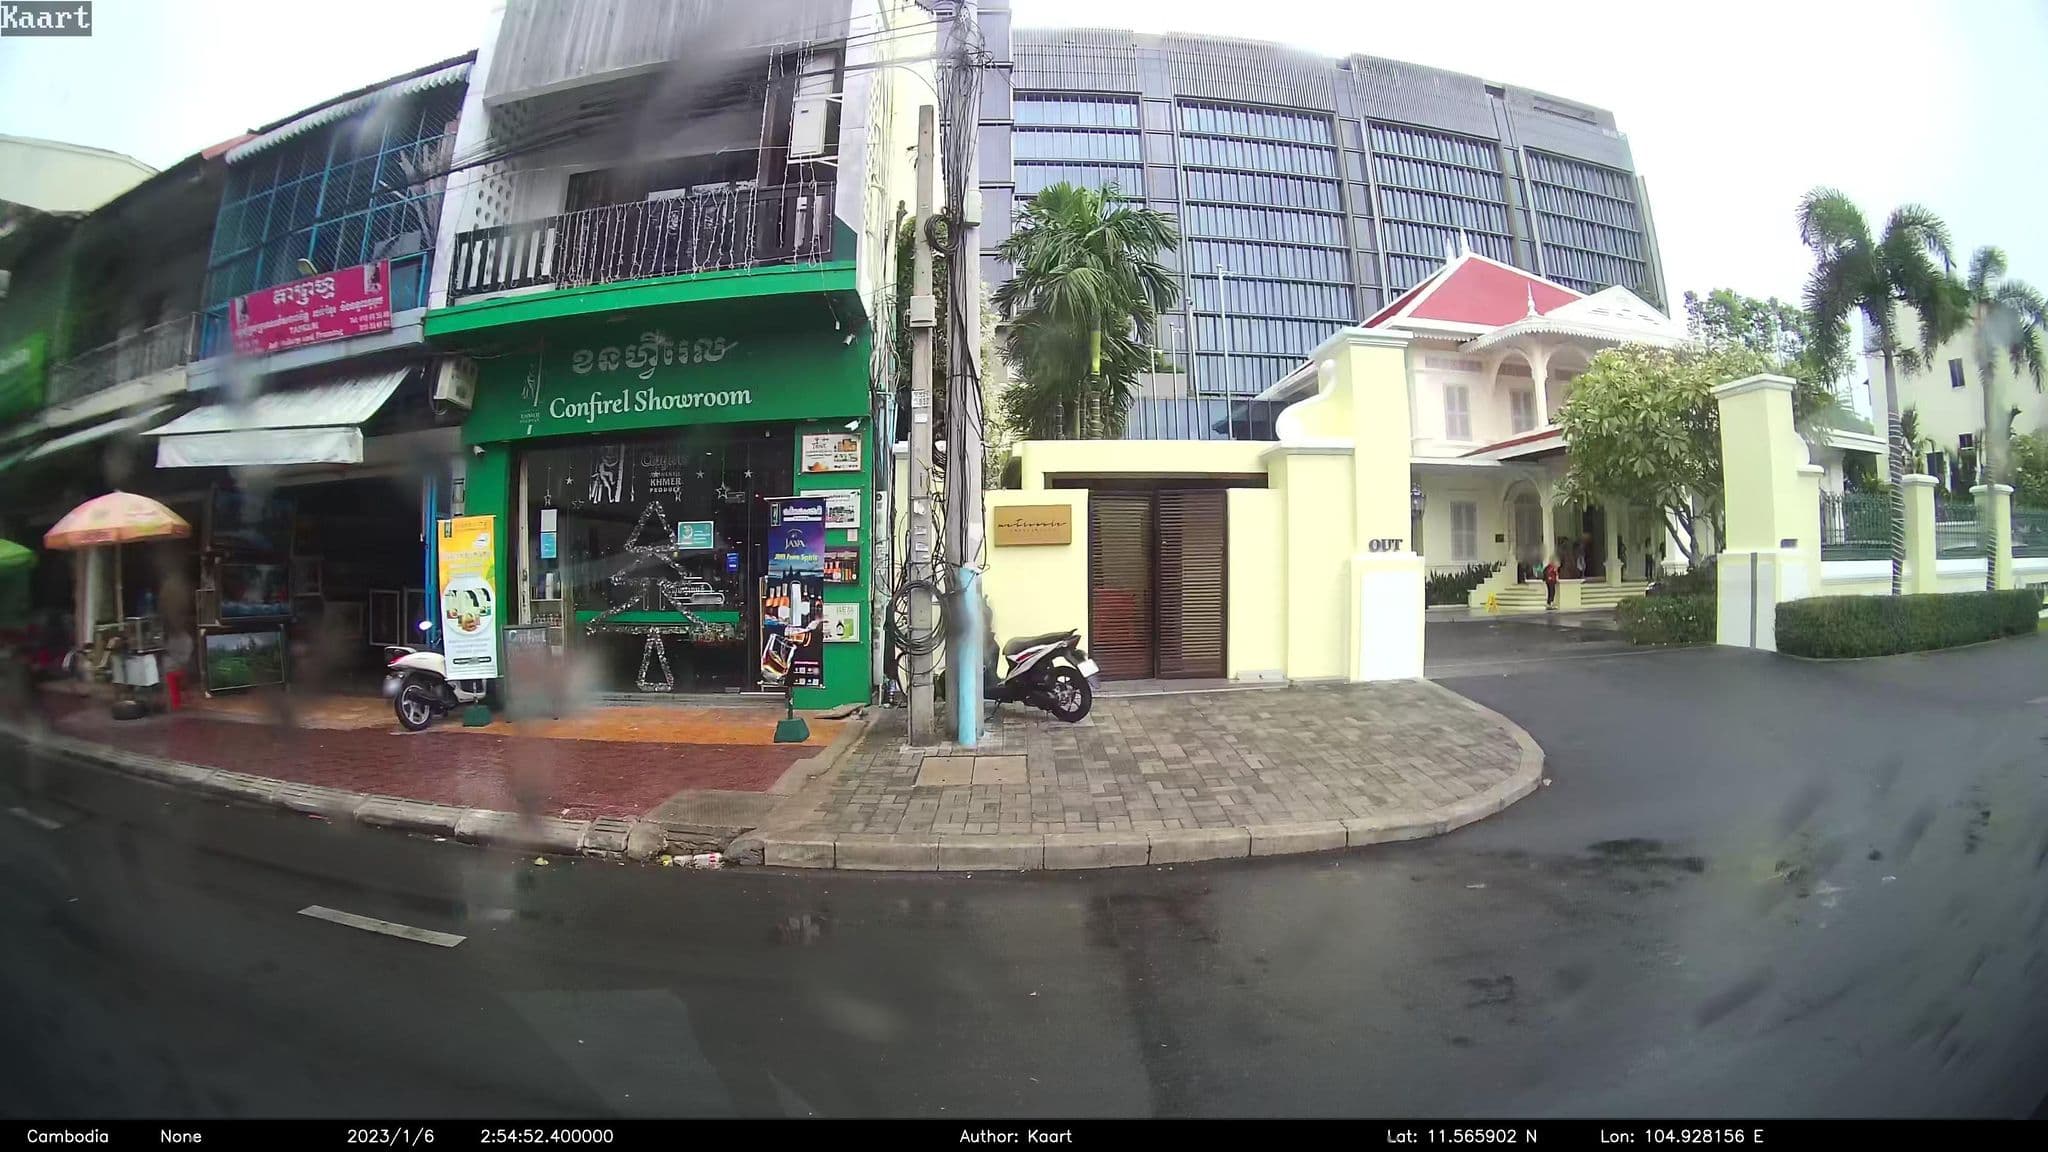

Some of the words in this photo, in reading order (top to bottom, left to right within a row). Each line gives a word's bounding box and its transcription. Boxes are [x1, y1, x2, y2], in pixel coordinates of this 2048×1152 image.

[549, 389, 630, 423] Confirel
[634, 388, 753, 412] Showroom
[650, 478, 681, 487] KHMER
[1368, 539, 1403, 552] OUT
